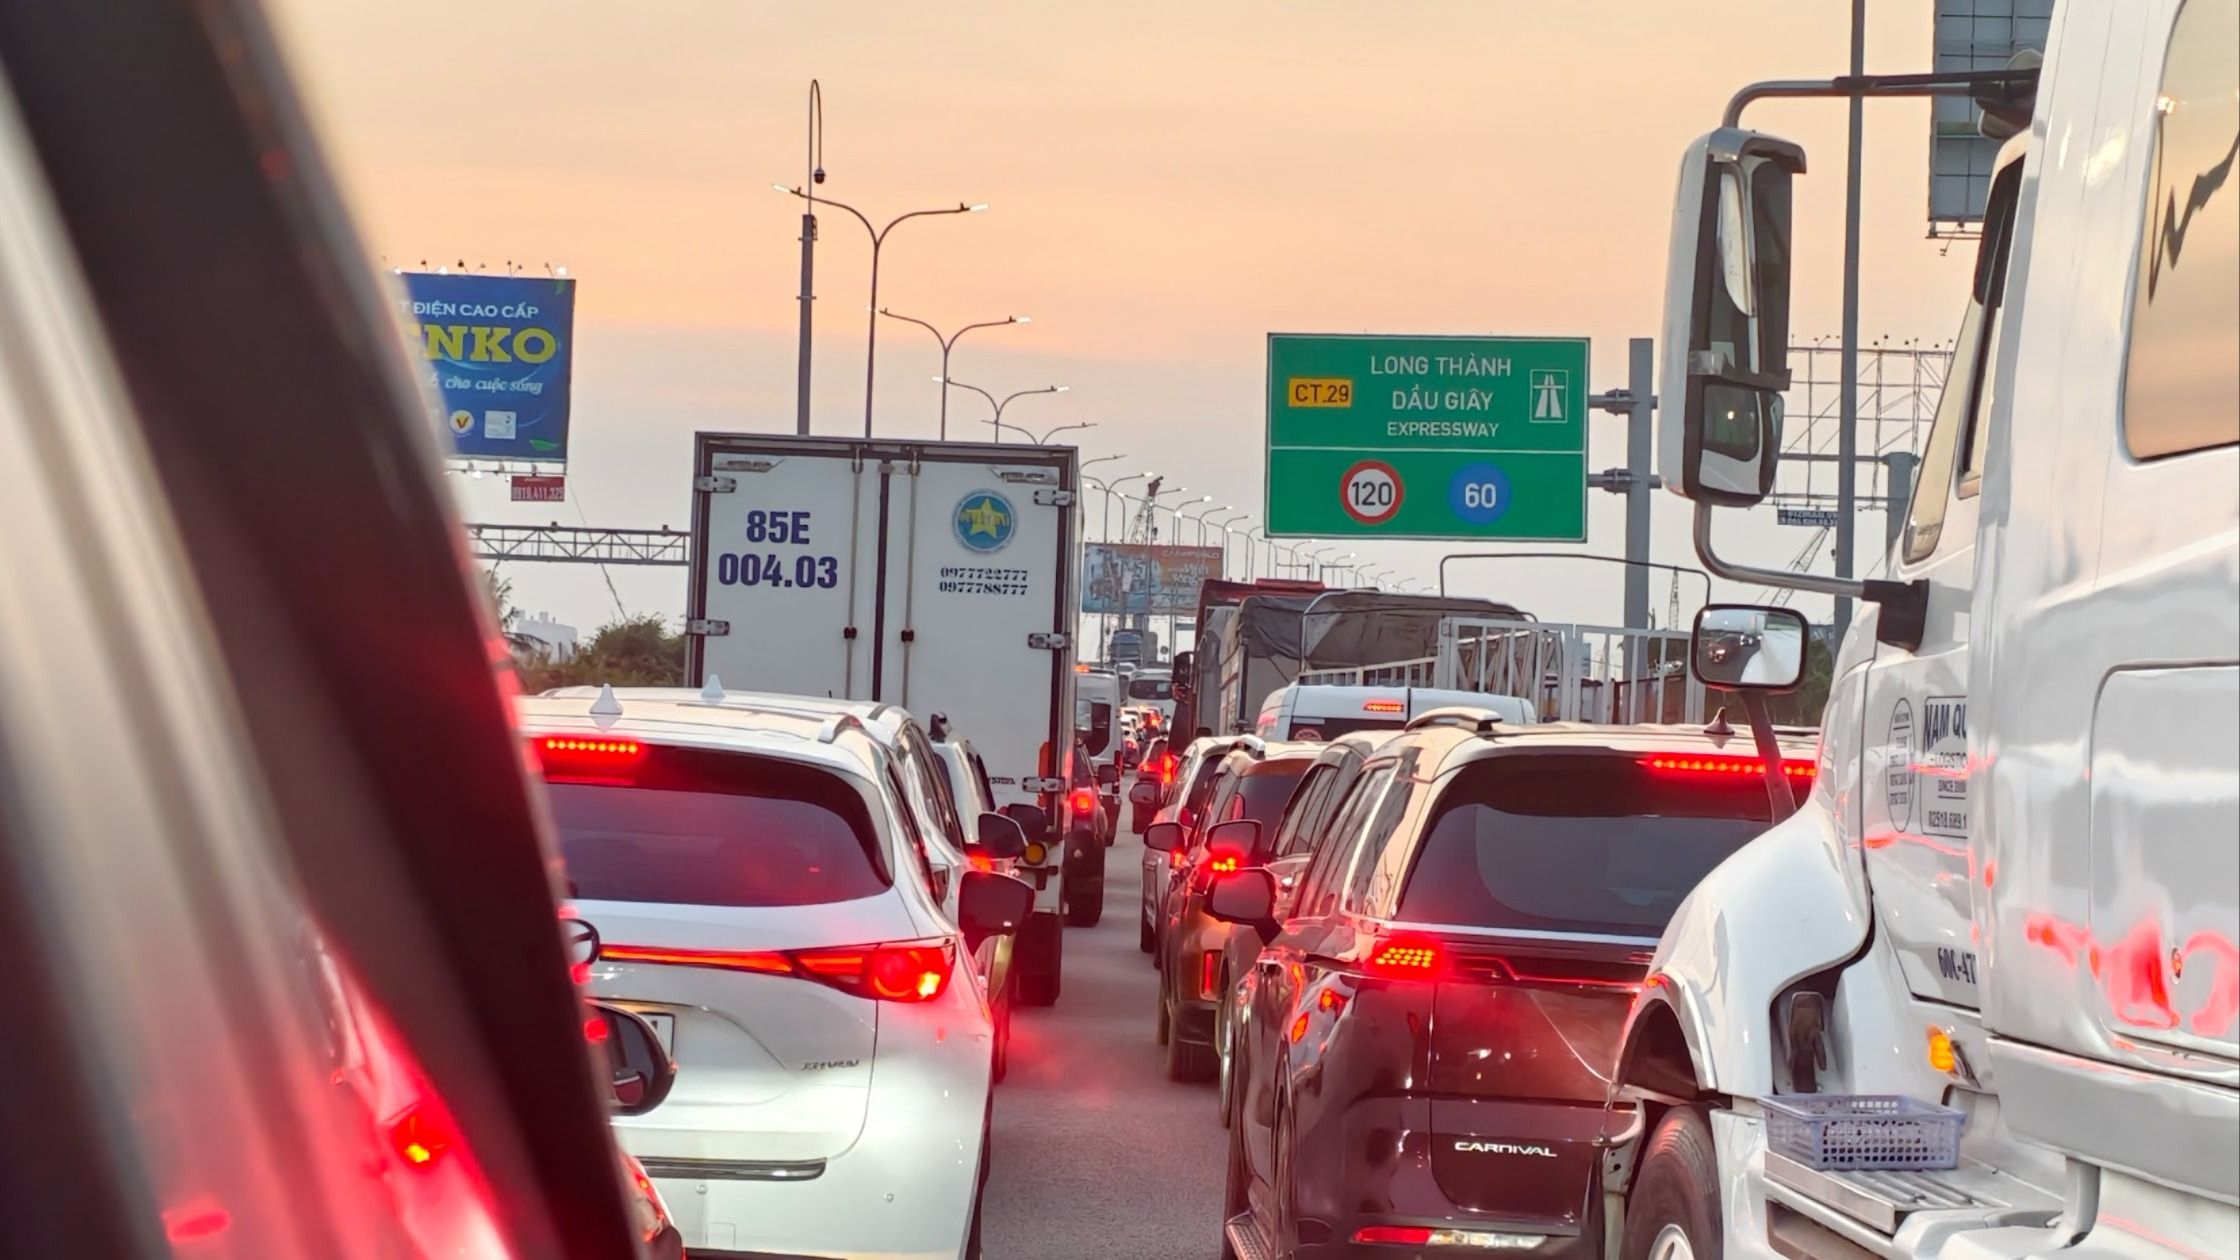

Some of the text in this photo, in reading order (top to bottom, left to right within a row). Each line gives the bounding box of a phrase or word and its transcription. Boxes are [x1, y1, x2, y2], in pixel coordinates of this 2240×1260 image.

[413, 300, 456, 317] ĐIỆN
[460, 304, 498, 317] CAO
[502, 302, 539, 318] CẤP
[411, 323, 556, 364] NKO
[1371, 353, 1512, 377] LONG THÀNH
[445, 376, 471, 389] cho
[475, 378, 508, 393] cuộc
[1294, 383, 1349, 403] CT.29
[1392, 384, 1493, 411] DẦU GIÂY
[1387, 421, 1499, 437] EXPRESSWAY
[1351, 481, 1393, 506] 120
[1465, 483, 1497, 508] 60
[746, 510, 811, 545] 85E
[718, 553, 838, 589] 004.03
[940, 567, 1028, 581] 0977722777
[939, 581, 1028, 596] 0977788777
[1922, 704, 1950, 755] NAM
[1454, 1141, 1558, 1157] CARNIVAL
